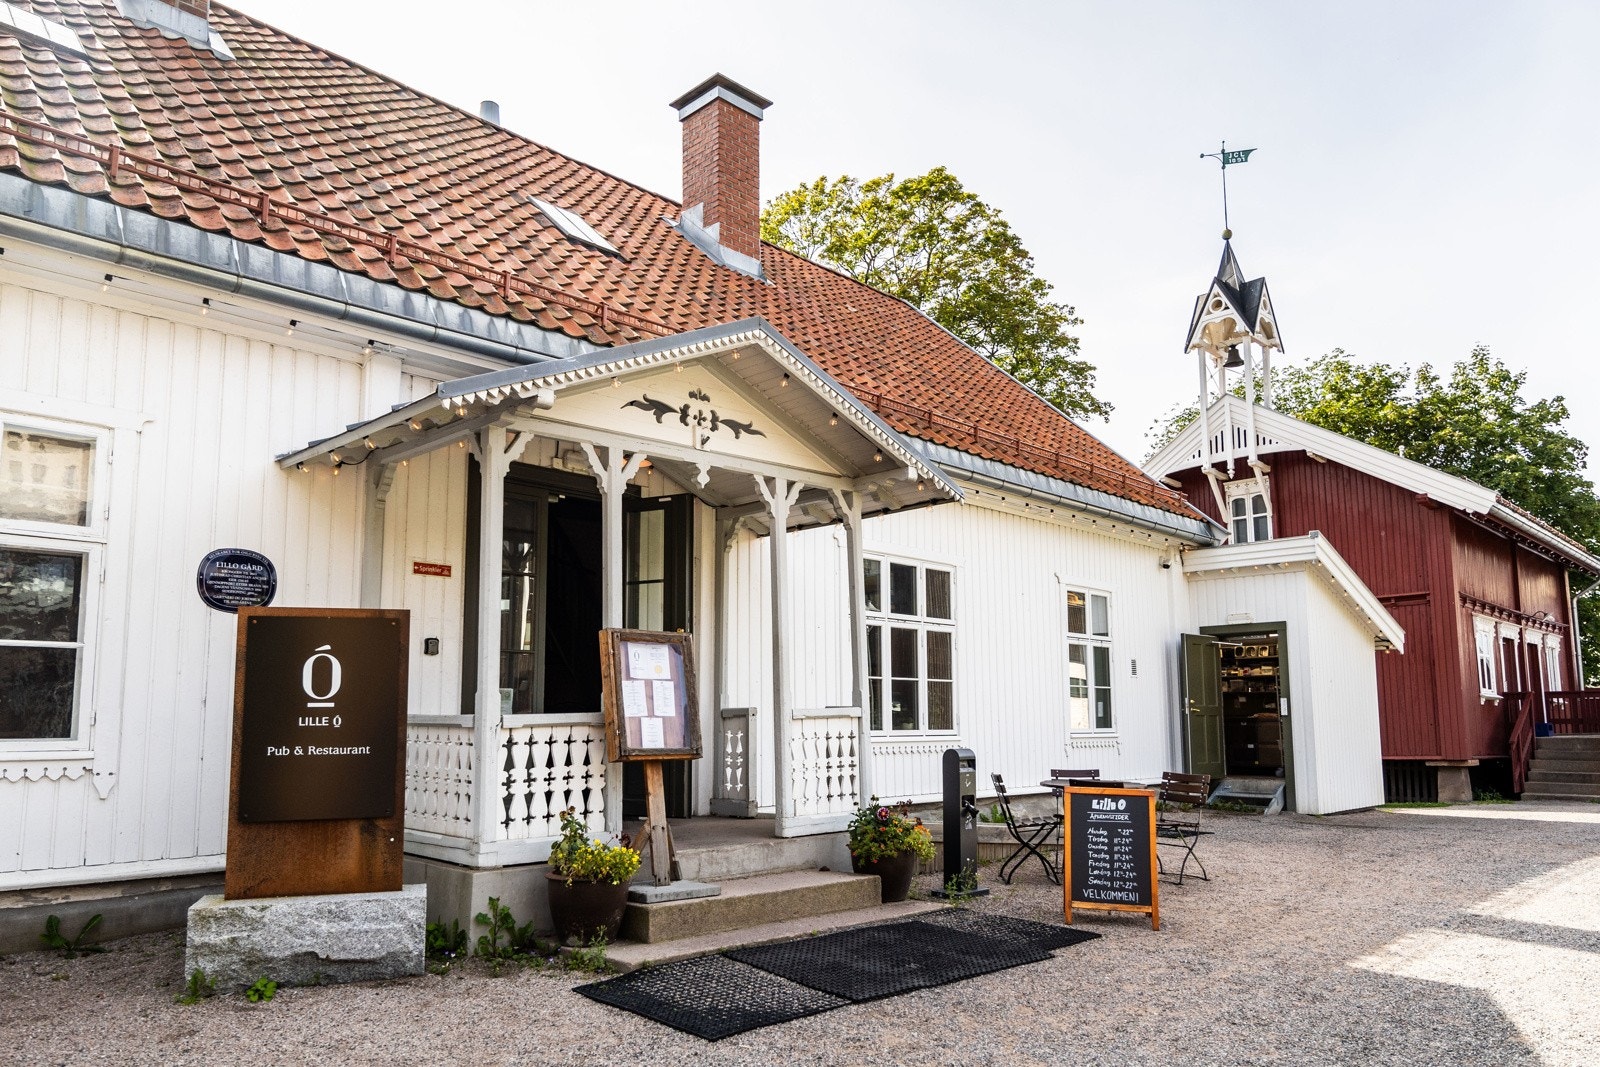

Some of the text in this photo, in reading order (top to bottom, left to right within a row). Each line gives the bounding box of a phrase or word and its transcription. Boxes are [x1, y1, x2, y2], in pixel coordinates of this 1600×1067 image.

[241, 563, 263, 571] GÅRD
[298, 717, 329, 726] LILLE
[267, 746, 370, 756] Pub & Restaurant
[1088, 860, 1110, 868] Fredag
[1088, 868, 1111, 877] Lørdag
[1088, 877, 1111, 887] Søndag
[1083, 889, 1139, 903] VELKOMMEN!
